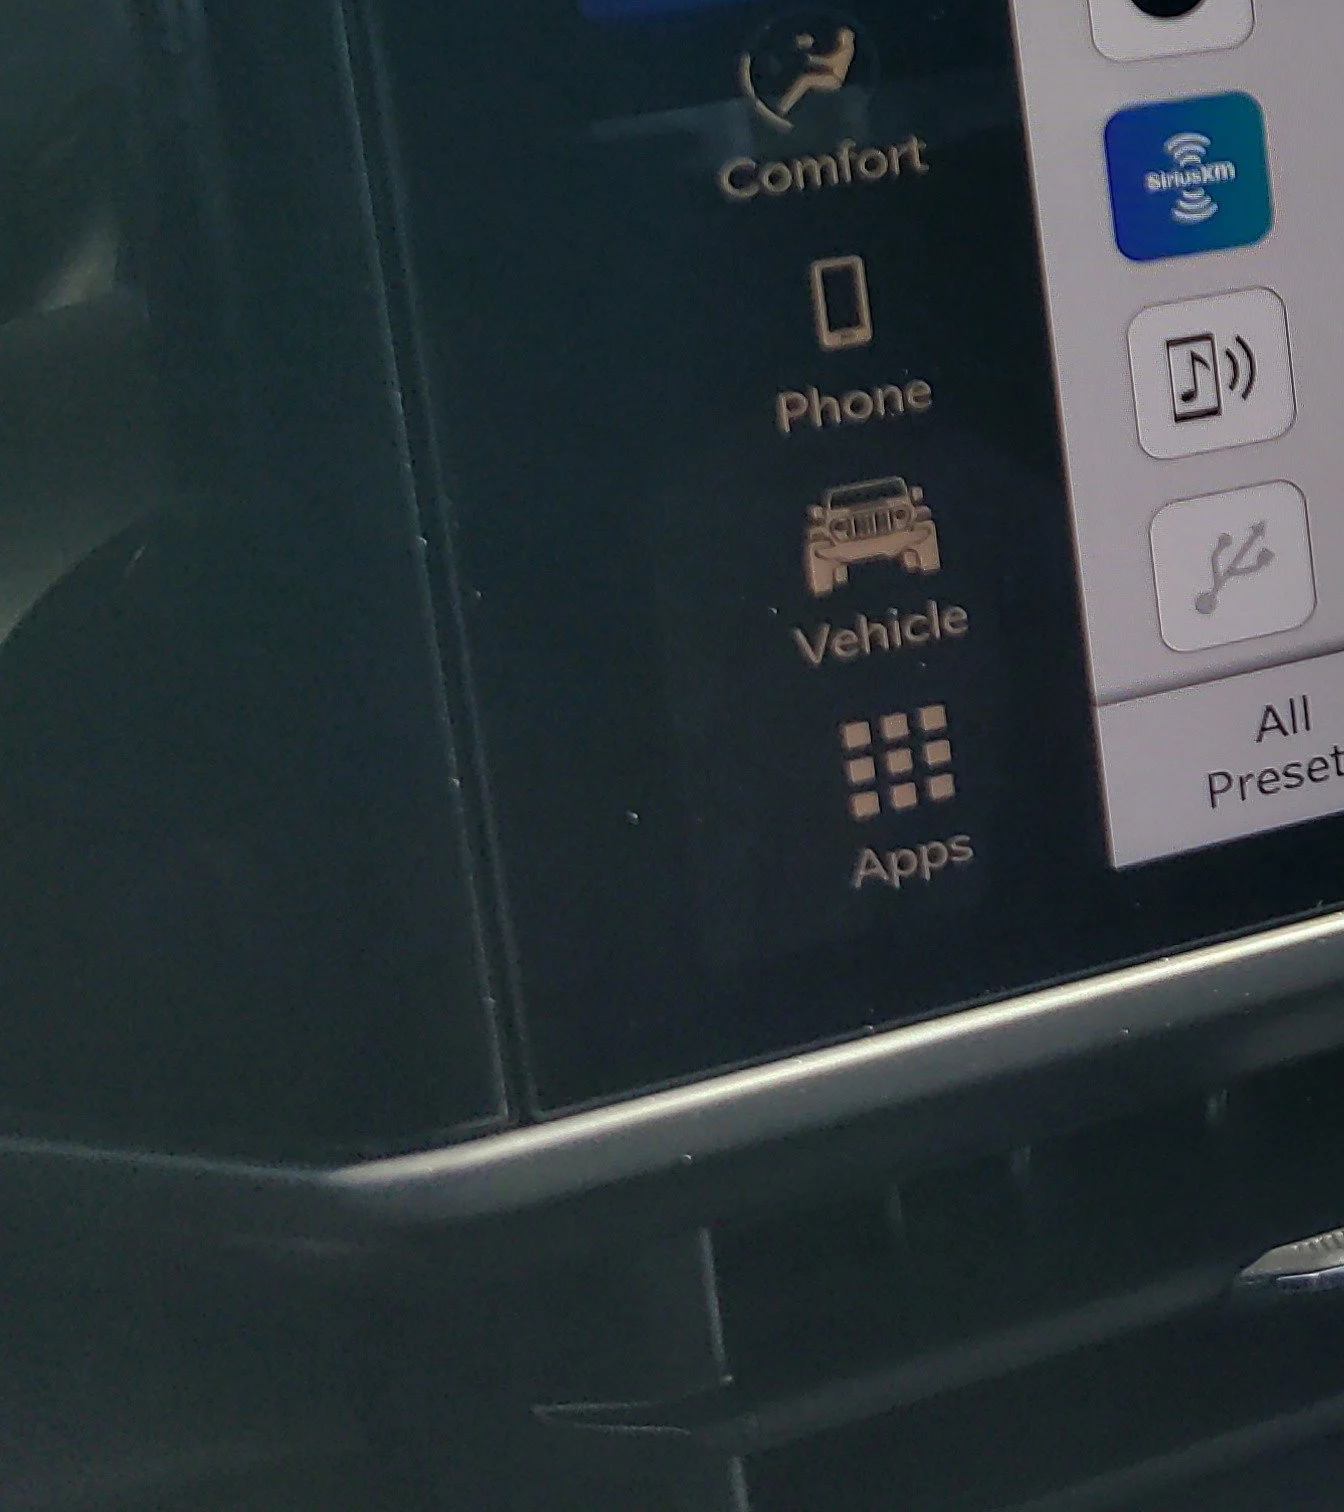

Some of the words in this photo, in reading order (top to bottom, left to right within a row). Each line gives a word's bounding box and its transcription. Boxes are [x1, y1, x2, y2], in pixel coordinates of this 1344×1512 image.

[718, 134, 930, 198] Comfort
[775, 376, 933, 435] Phone
[793, 600, 969, 665] Vehicle
[1253, 694, 1312, 743] All
[852, 833, 973, 887] Apps
